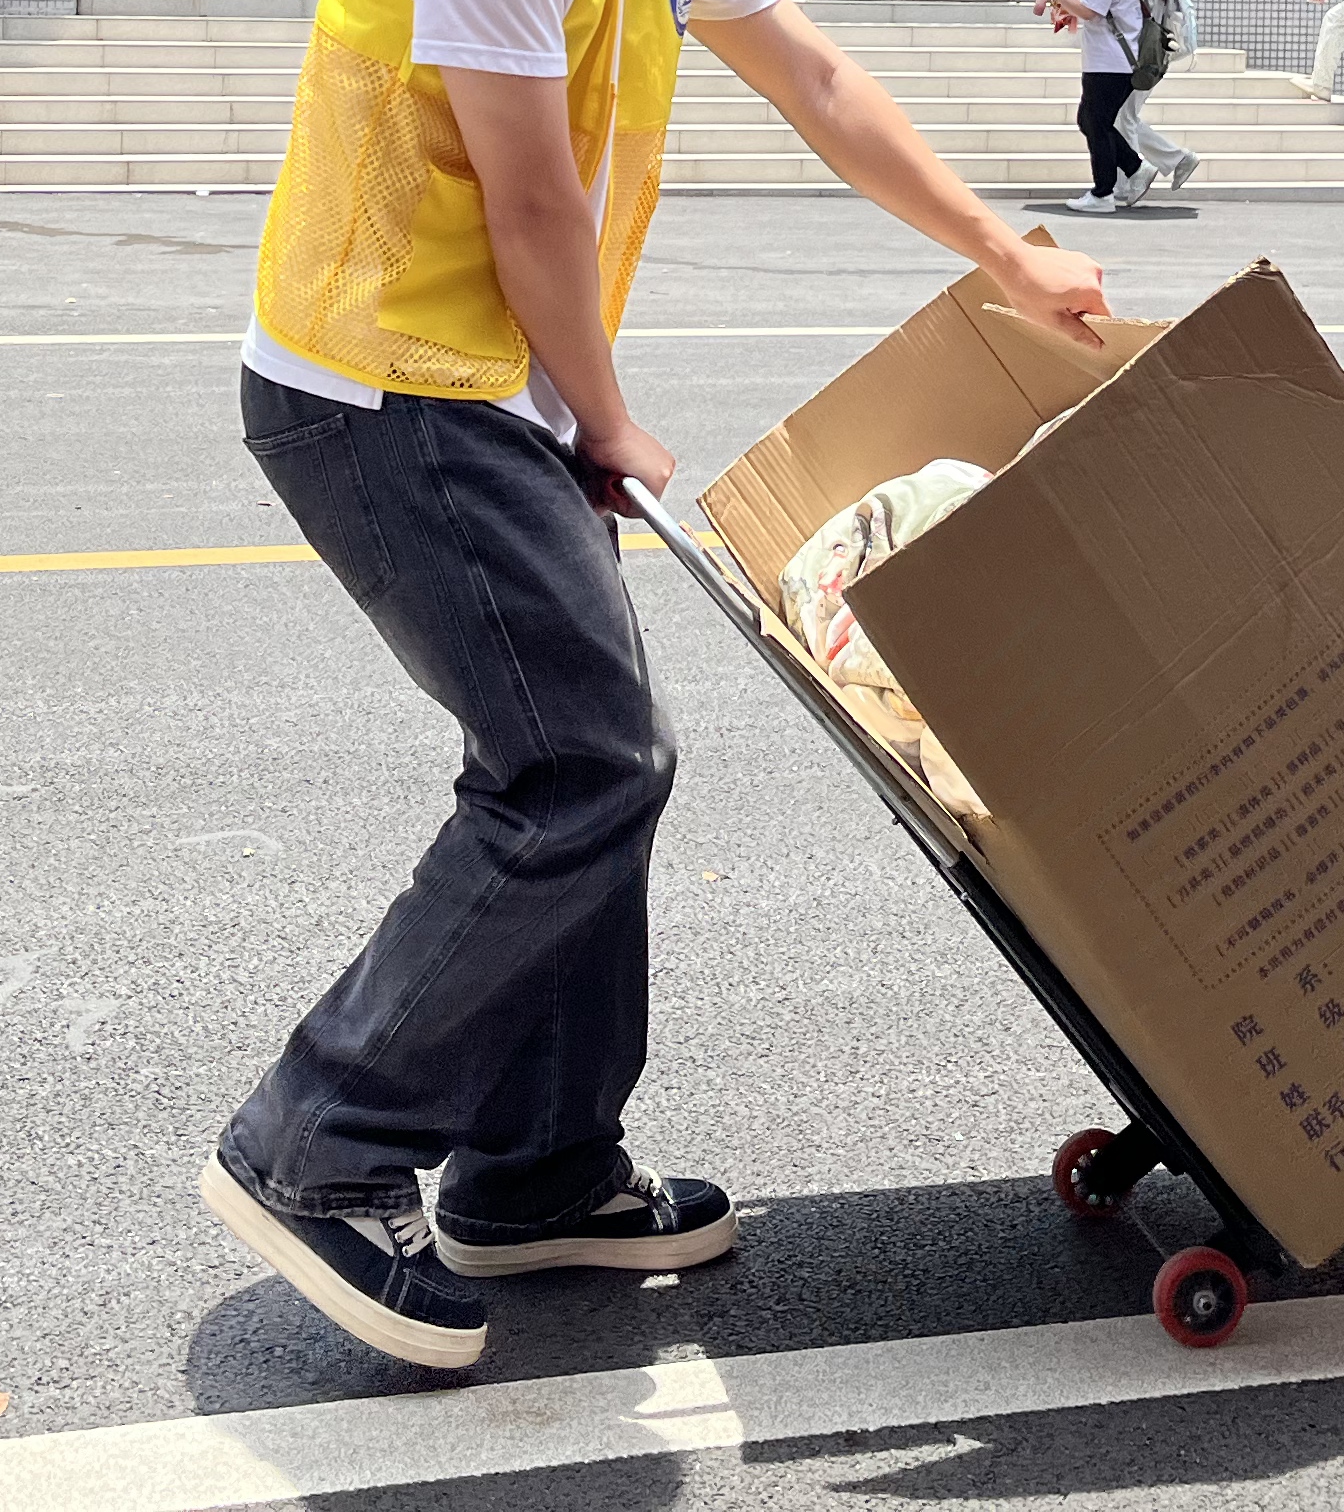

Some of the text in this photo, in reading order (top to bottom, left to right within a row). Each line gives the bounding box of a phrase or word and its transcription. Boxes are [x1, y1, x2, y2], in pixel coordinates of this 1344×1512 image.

[1231, 1014, 1263, 1046] 院
[1255, 1046, 1287, 1079] 班
[1279, 1082, 1310, 1112] 姓
